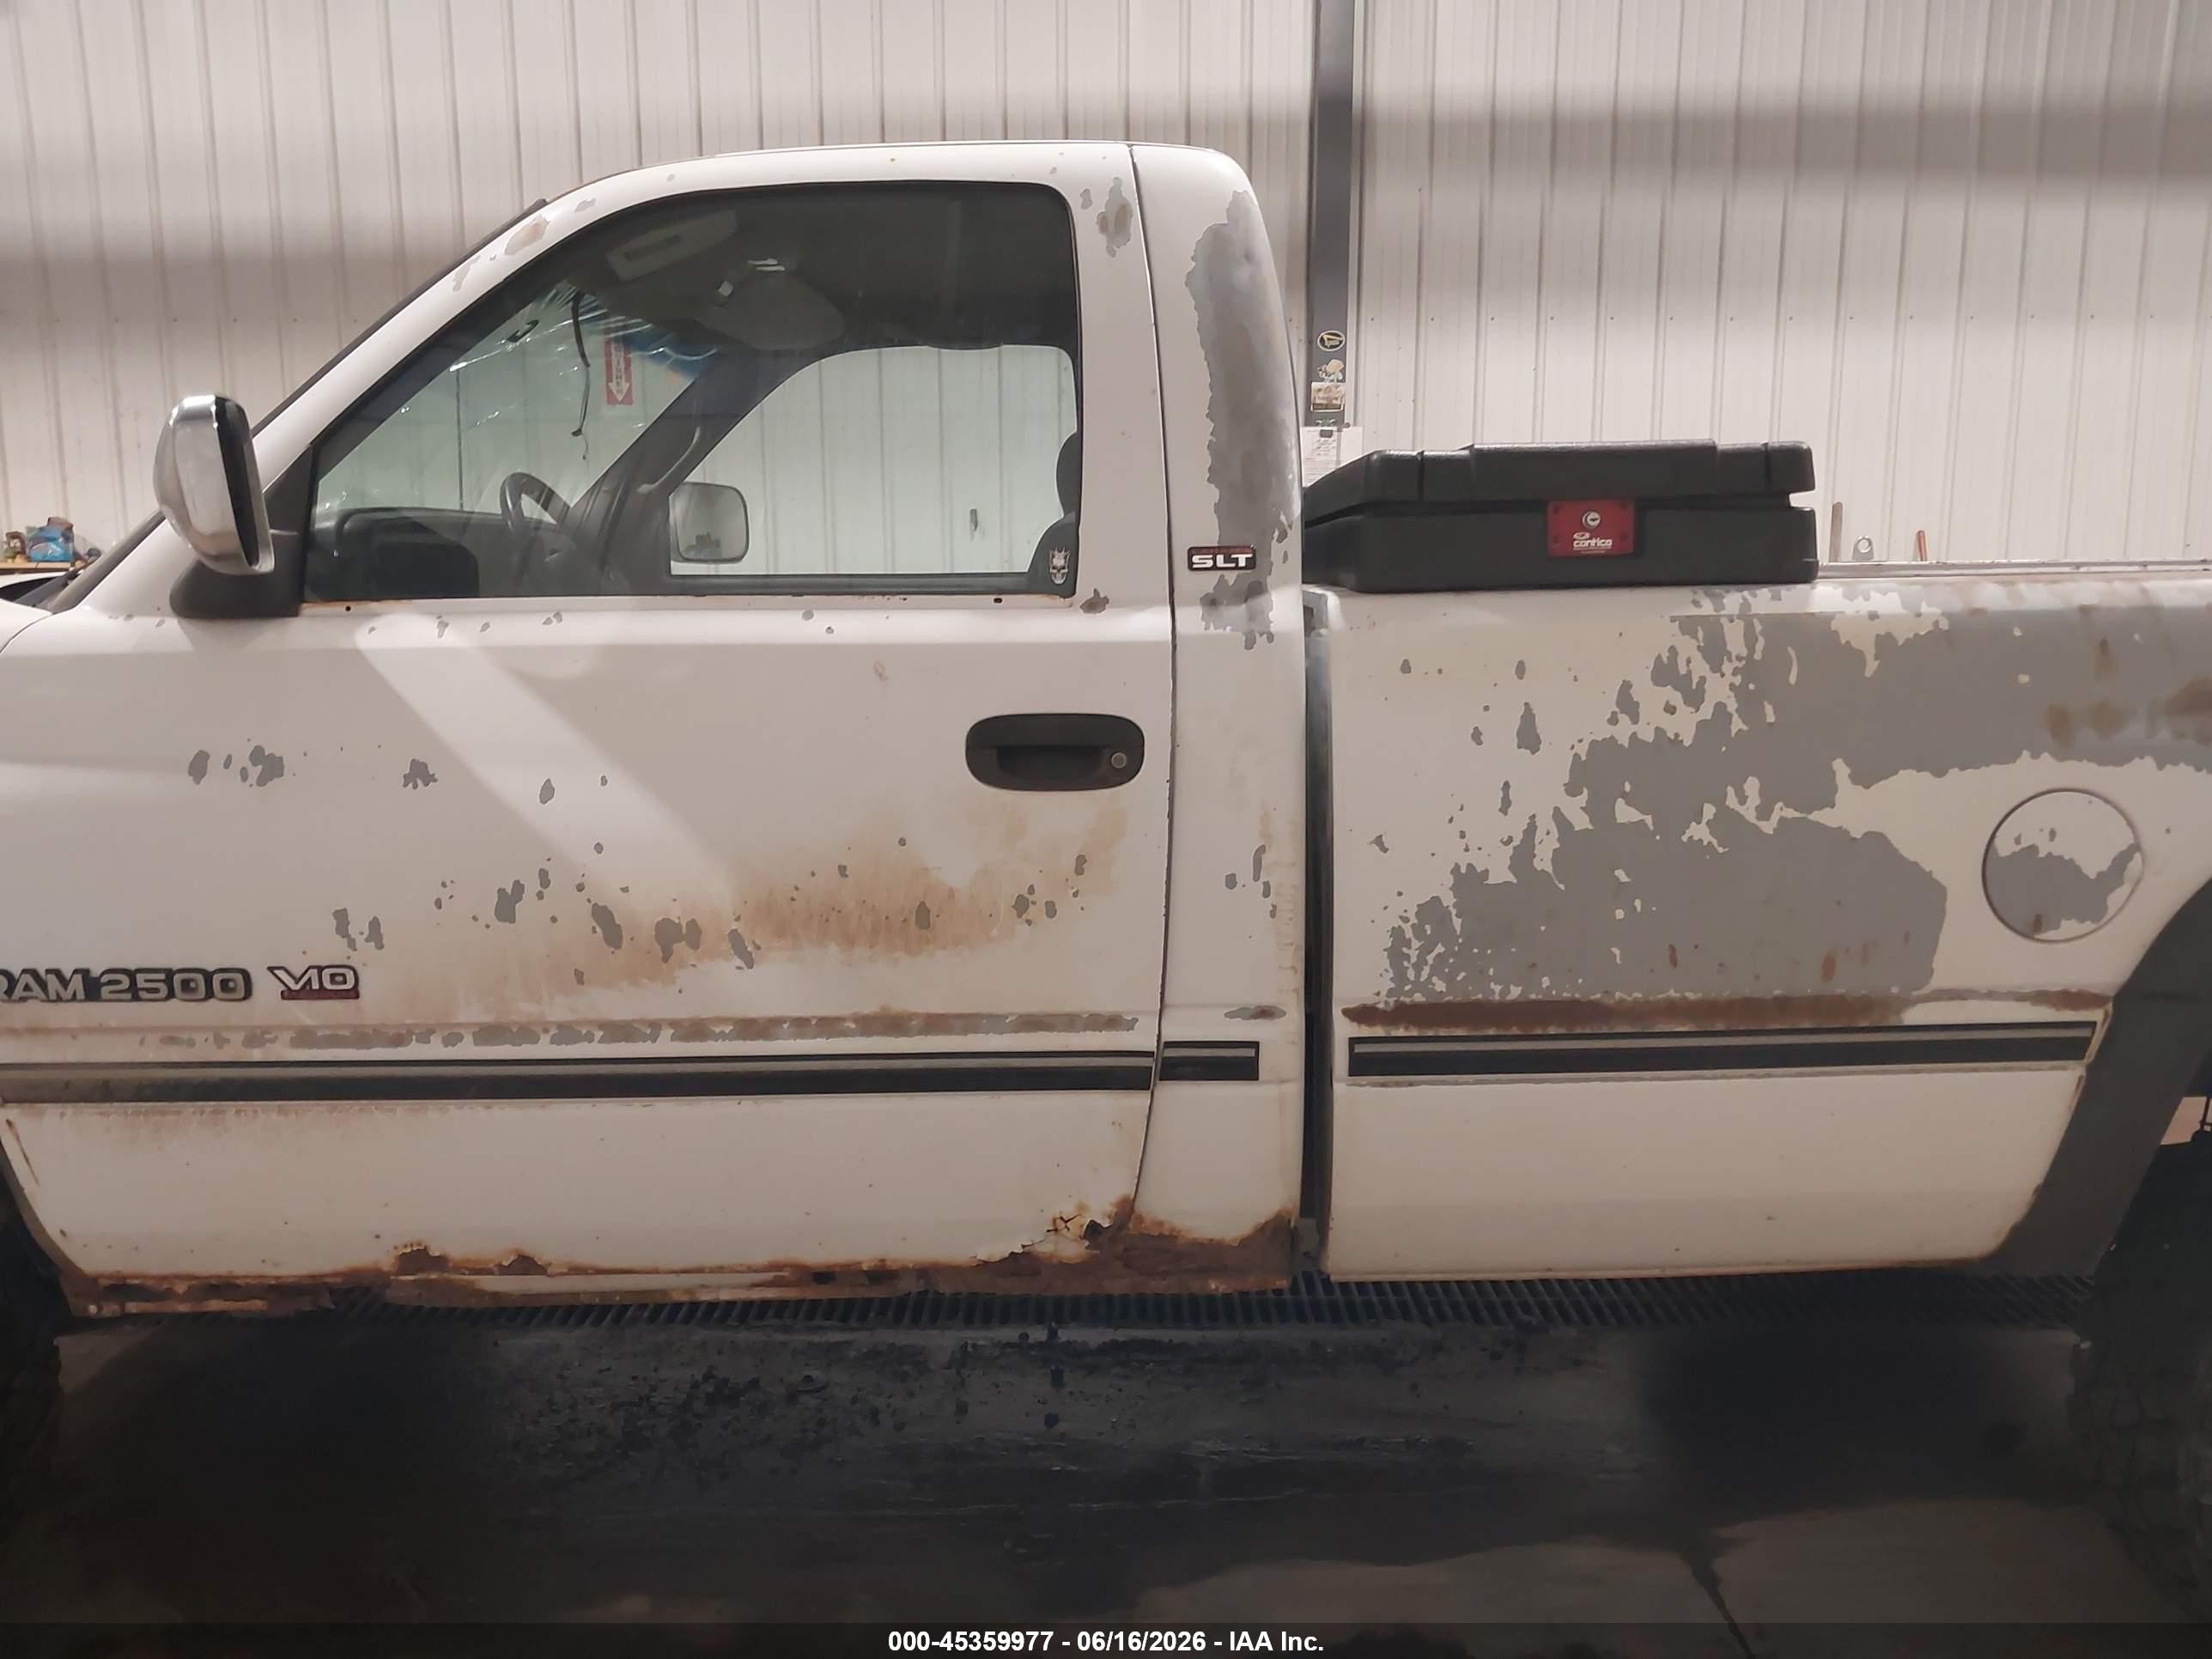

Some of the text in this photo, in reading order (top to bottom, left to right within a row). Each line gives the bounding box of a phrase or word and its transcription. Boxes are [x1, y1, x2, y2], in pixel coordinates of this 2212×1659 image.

[1572, 537, 1613, 548] contico
[1191, 553, 1254, 568] SLT
[99, 970, 249, 1001] 2500
[270, 967, 358, 992] V10
